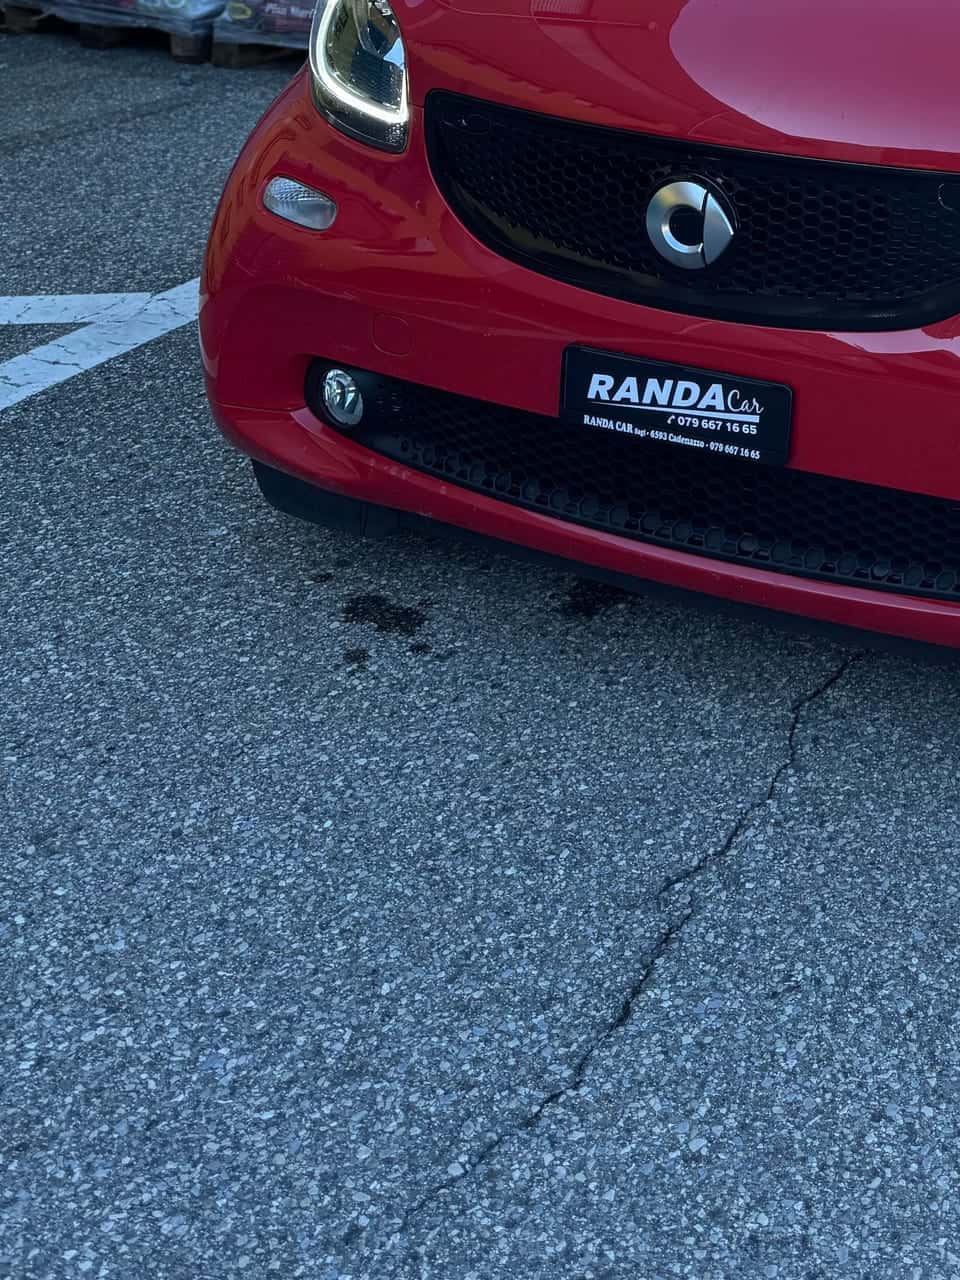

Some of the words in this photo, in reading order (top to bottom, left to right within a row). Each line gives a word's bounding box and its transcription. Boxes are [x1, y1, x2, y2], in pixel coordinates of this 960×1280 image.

[587, 374, 725, 410] RANDA
[727, 389, 765, 414] Car
[583, 414, 614, 430] RANDA
[616, 421, 634, 434] CAR
[650, 430, 667, 442] 6593
[668, 433, 704, 448] Cadenazzo
[709, 441, 723, 453] 079
[724, 444, 739, 456] 667
[740, 447, 750, 458] 16
[750, 449, 760, 461] 65
[677, 416, 699, 428] 079
[701, 419, 722, 432] 667
[726, 423, 739, 433] 16
[742, 424, 758, 435] 65
